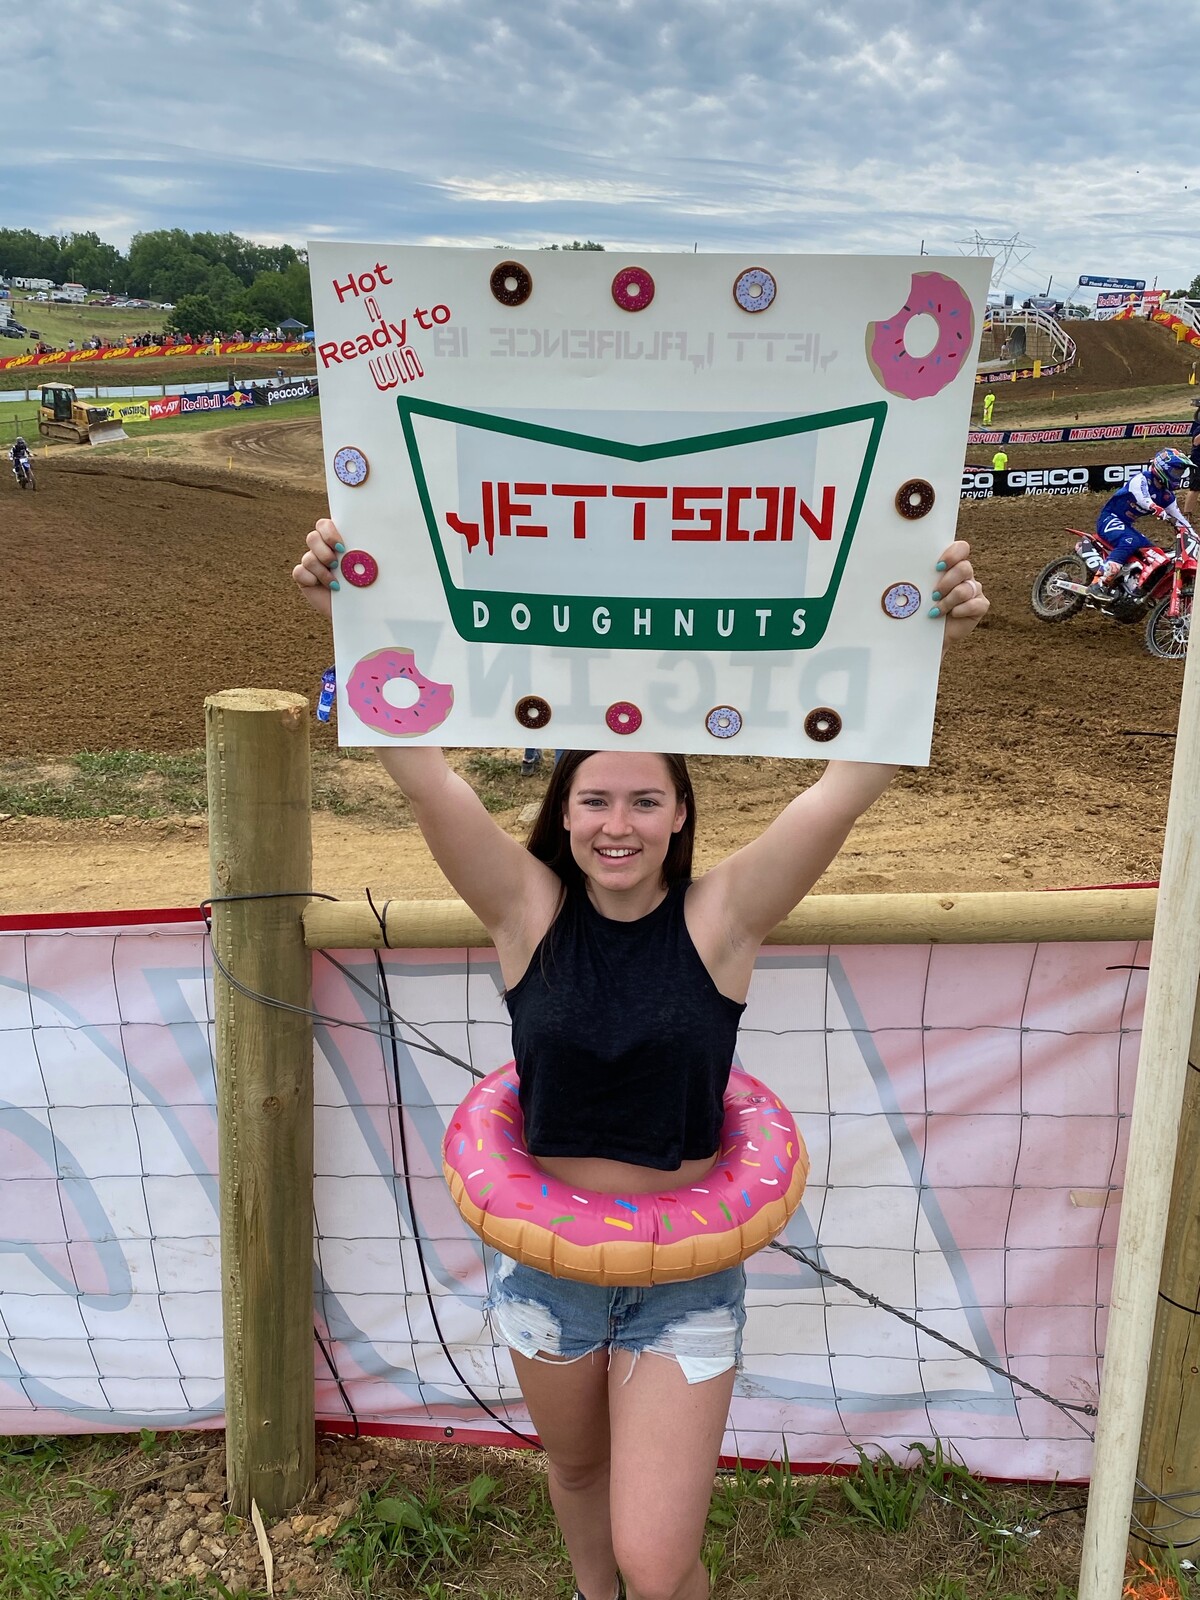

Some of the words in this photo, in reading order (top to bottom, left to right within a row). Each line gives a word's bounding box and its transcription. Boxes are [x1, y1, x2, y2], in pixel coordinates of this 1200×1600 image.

[332, 262, 393, 303] Hot
[364, 295, 381, 322] n
[318, 319, 407, 368] Ready
[413, 304, 451, 329] to
[268, 383, 310, 406] peacock
[961, 473, 994, 489] CO
[1007, 468, 1089, 488] GEICO
[1025, 484, 1089, 497] Motorcycle
[961, 489, 994, 500] rcycle
[446, 482, 836, 556] JETTSON
[473, 600, 807, 638] DOUGHNUTS
